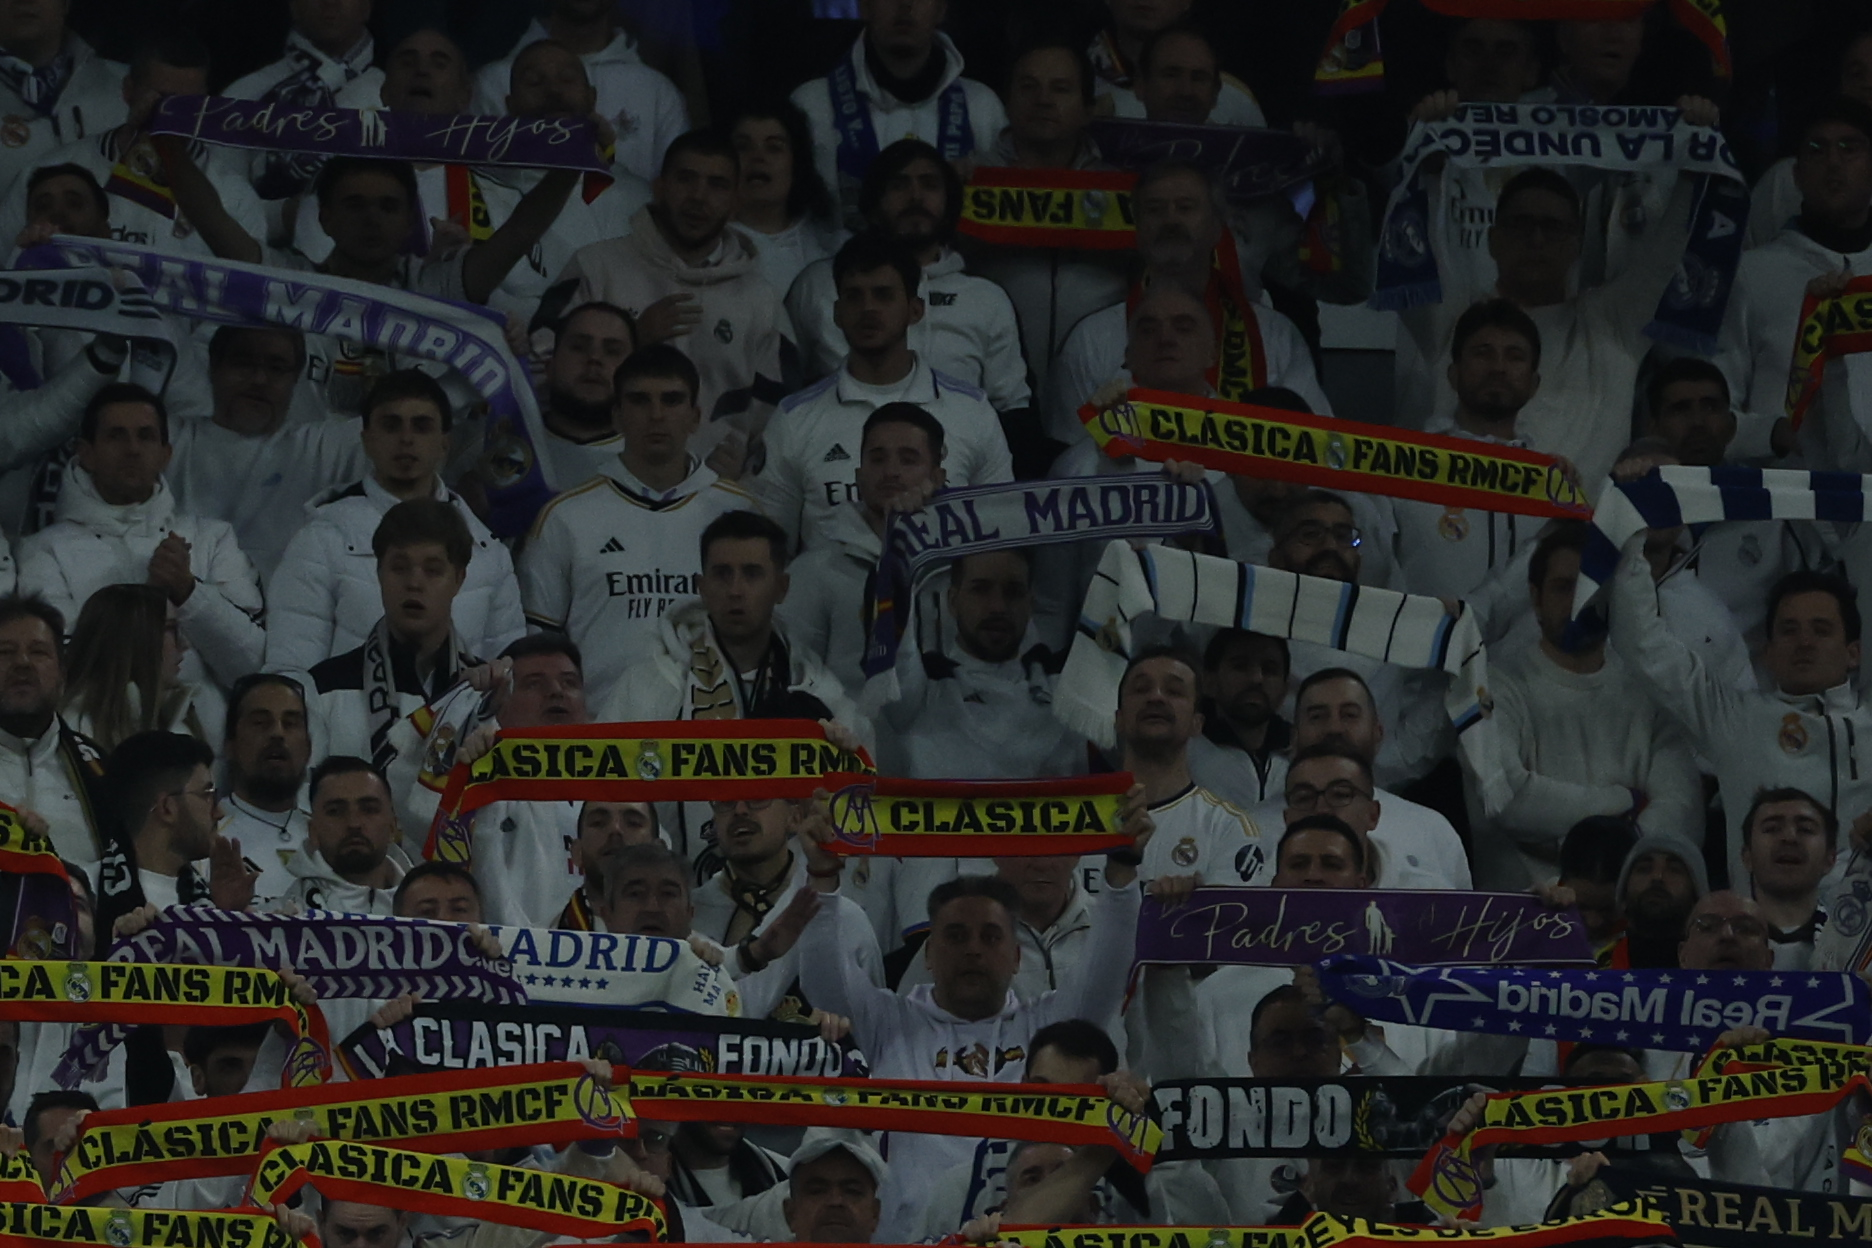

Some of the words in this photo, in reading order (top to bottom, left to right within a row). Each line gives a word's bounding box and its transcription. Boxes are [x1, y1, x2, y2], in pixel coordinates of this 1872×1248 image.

[192, 94, 346, 143] Padres
[1443, 130, 1602, 160] UNDÉC
[1617, 131, 1674, 160] LA
[971, 188, 1074, 224] FANS
[264, 280, 509, 398] MADRID
[1150, 403, 1317, 464] CLÁSICA
[1351, 438, 1439, 476] FANS
[1448, 454, 1549, 492] RMCF
[893, 510, 1000, 558] REAL
[1027, 483, 1206, 533] MADRID
[607, 570, 700, 597] Emirat
[670, 743, 777, 776] FANS
[890, 800, 1106, 834] CLASICA
[250, 924, 440, 974] MADRID
[1171, 901, 1359, 951] Padres
[101, 966, 210, 1003] FANS
[413, 1018, 591, 1070] CLASICA
[1698, 1066, 1806, 1104] FANS
[328, 1098, 437, 1140] FANS
[449, 1084, 569, 1129] RMCF
[1153, 1082, 1354, 1151] FONDO
[497, 1165, 604, 1216] FANS
[1677, 1188, 1815, 1238] REAL
